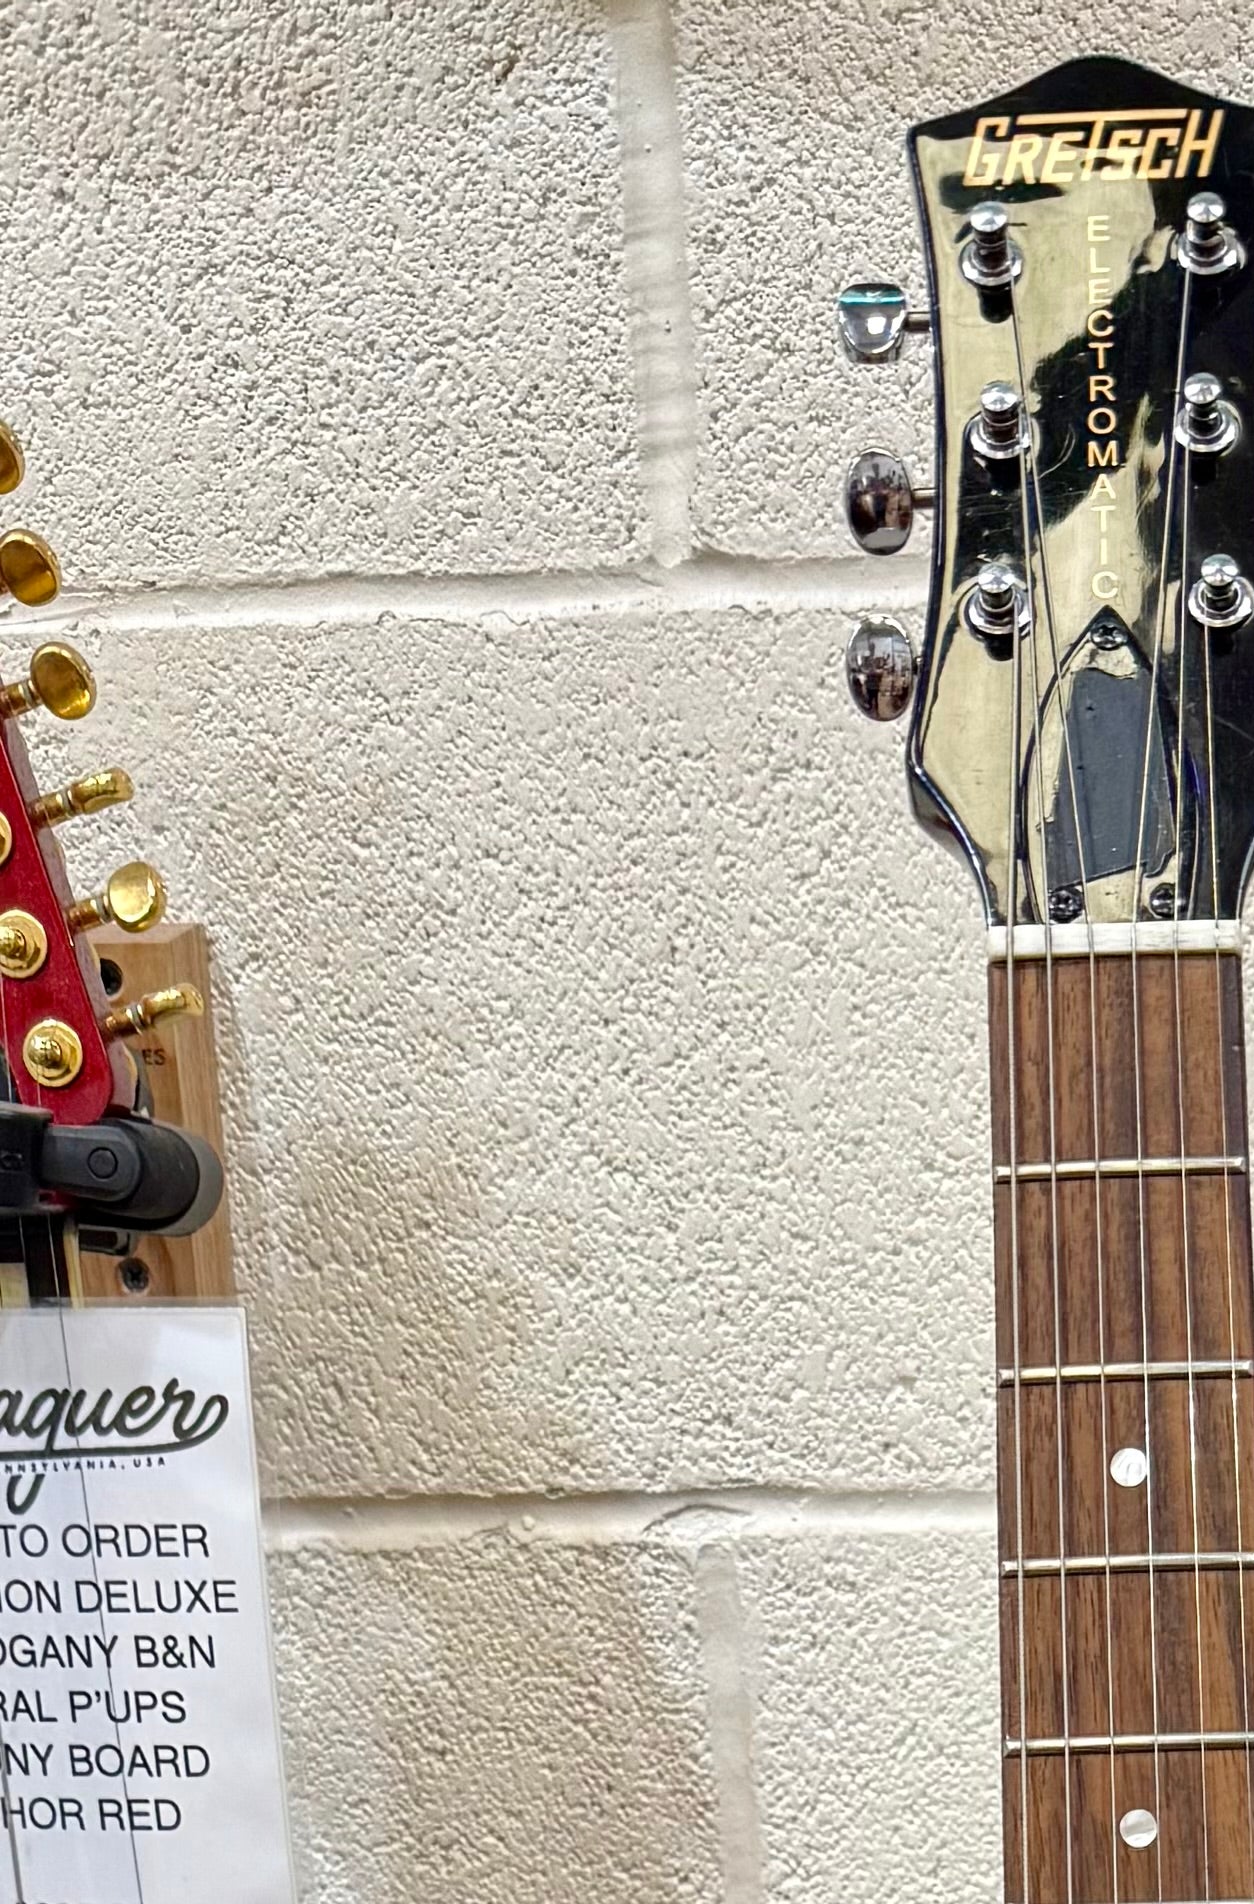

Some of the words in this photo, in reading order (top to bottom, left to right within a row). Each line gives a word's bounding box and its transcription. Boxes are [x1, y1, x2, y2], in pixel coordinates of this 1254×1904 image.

[963, 108, 1225, 188] GRETSCH
[1086, 213, 1119, 600] ELECTROMATIC
[62, 1523, 210, 1558] ORDER
[75, 1579, 240, 1614] DELUXE
[0, 1634, 118, 1669] GANY
[134, 1634, 216, 1669] B&N
[68, 1689, 188, 1724] P'UPS
[68, 1743, 211, 1778] BOARD
[98, 1797, 182, 1832] RED
